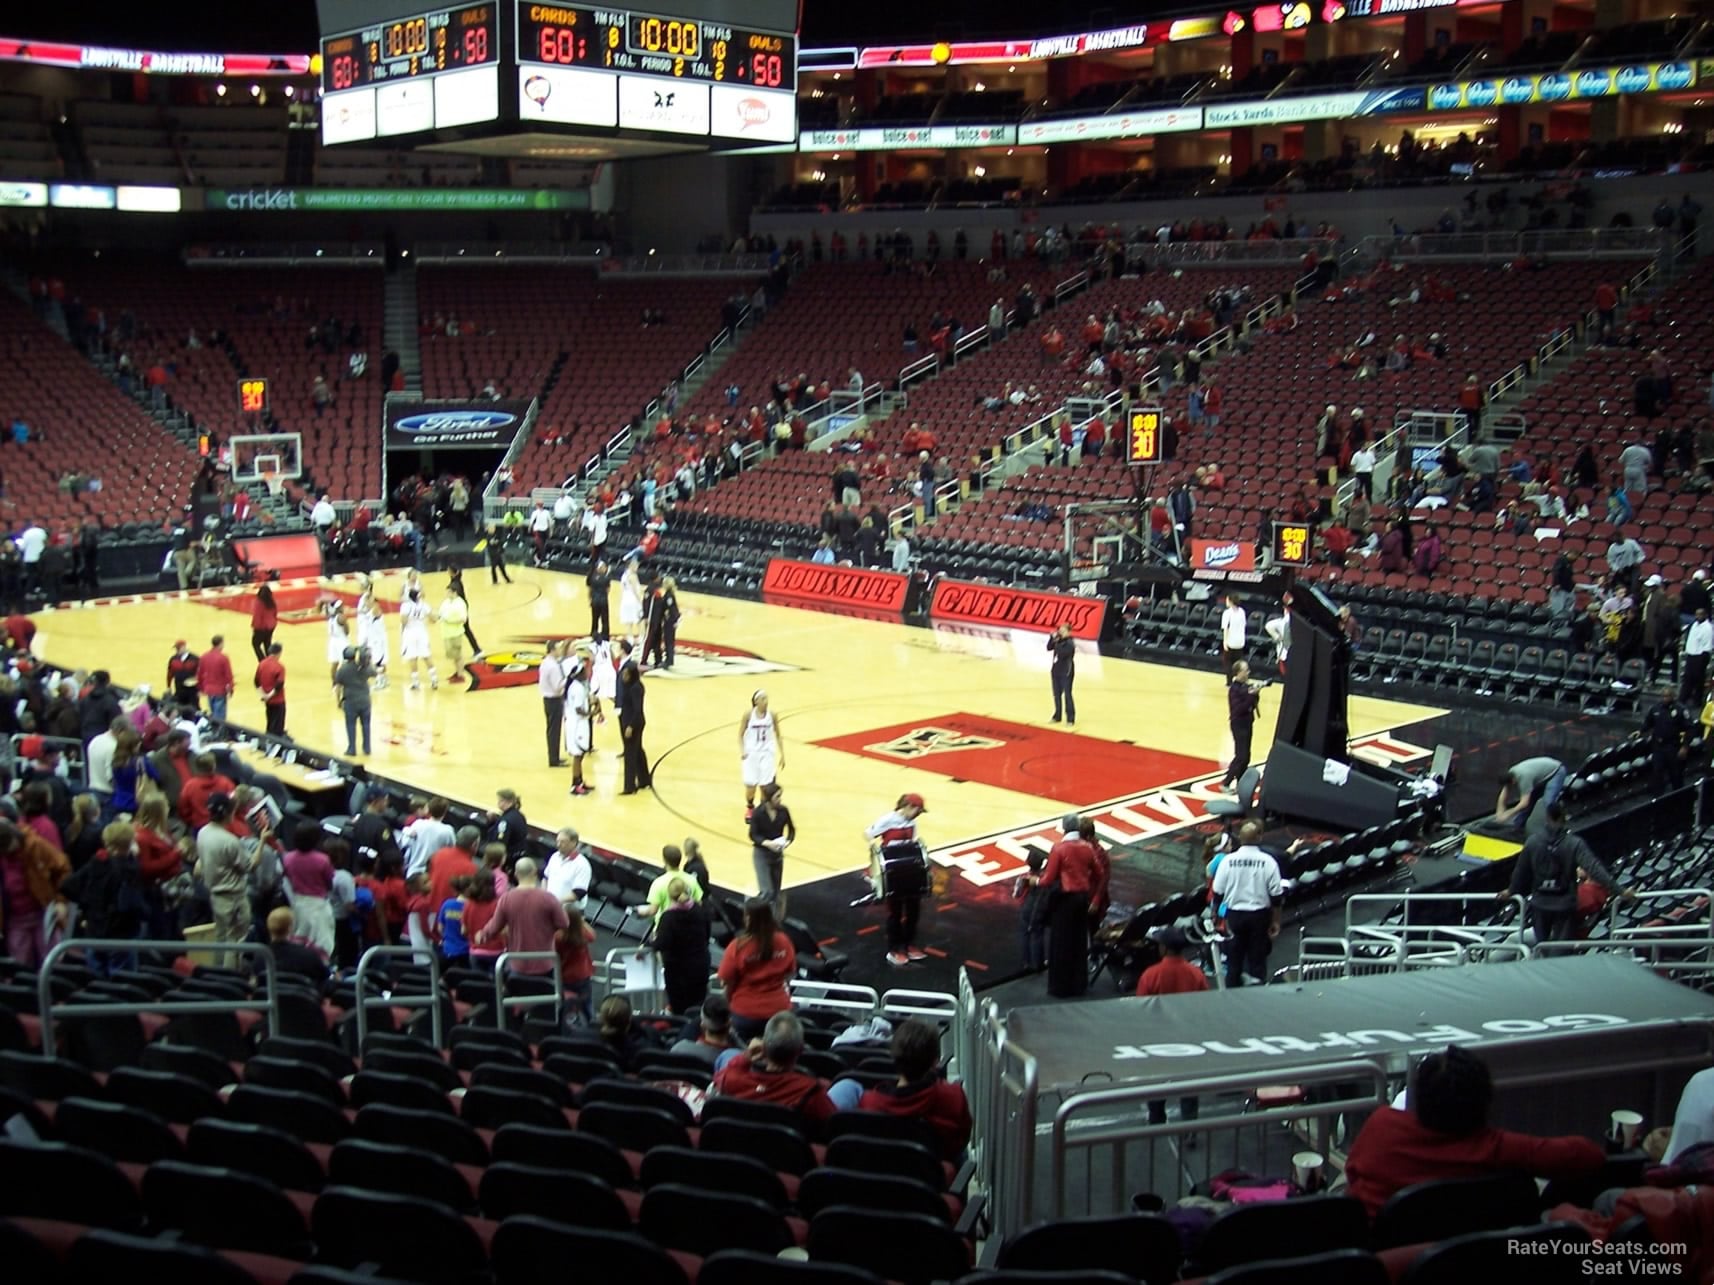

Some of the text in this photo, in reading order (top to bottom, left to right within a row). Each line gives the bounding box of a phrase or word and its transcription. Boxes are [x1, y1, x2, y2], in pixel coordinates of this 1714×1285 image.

[531, 6, 577, 25] CARDS
[594, 11, 624, 27] TM FLS
[465, 28, 487, 63] 50
[541, 27, 573, 63] 60
[641, 18, 697, 55] 10:00
[749, 35, 782, 51] OWLS
[641, 56, 672, 72] PERIOD
[674, 57, 684, 76] 2
[715, 61, 725, 80] 2
[753, 53, 781, 86] 50
[1209, 111, 1239, 123] Stock
[1244, 108, 1274, 120] Yards
[226, 189, 296, 210] cricket
[420, 416, 491, 433] Ford
[413, 431, 499, 443] Go Further
[1132, 430, 1154, 459] 30
[1204, 543, 1240, 563] Dean's
[1283, 542, 1302, 560] 30
[773, 565, 898, 605] LOUISVILLE
[937, 586, 1097, 632] CARDINALS
[1229, 859, 1266, 868] SECURITY
[1113, 1013, 1630, 1060] Go Further
